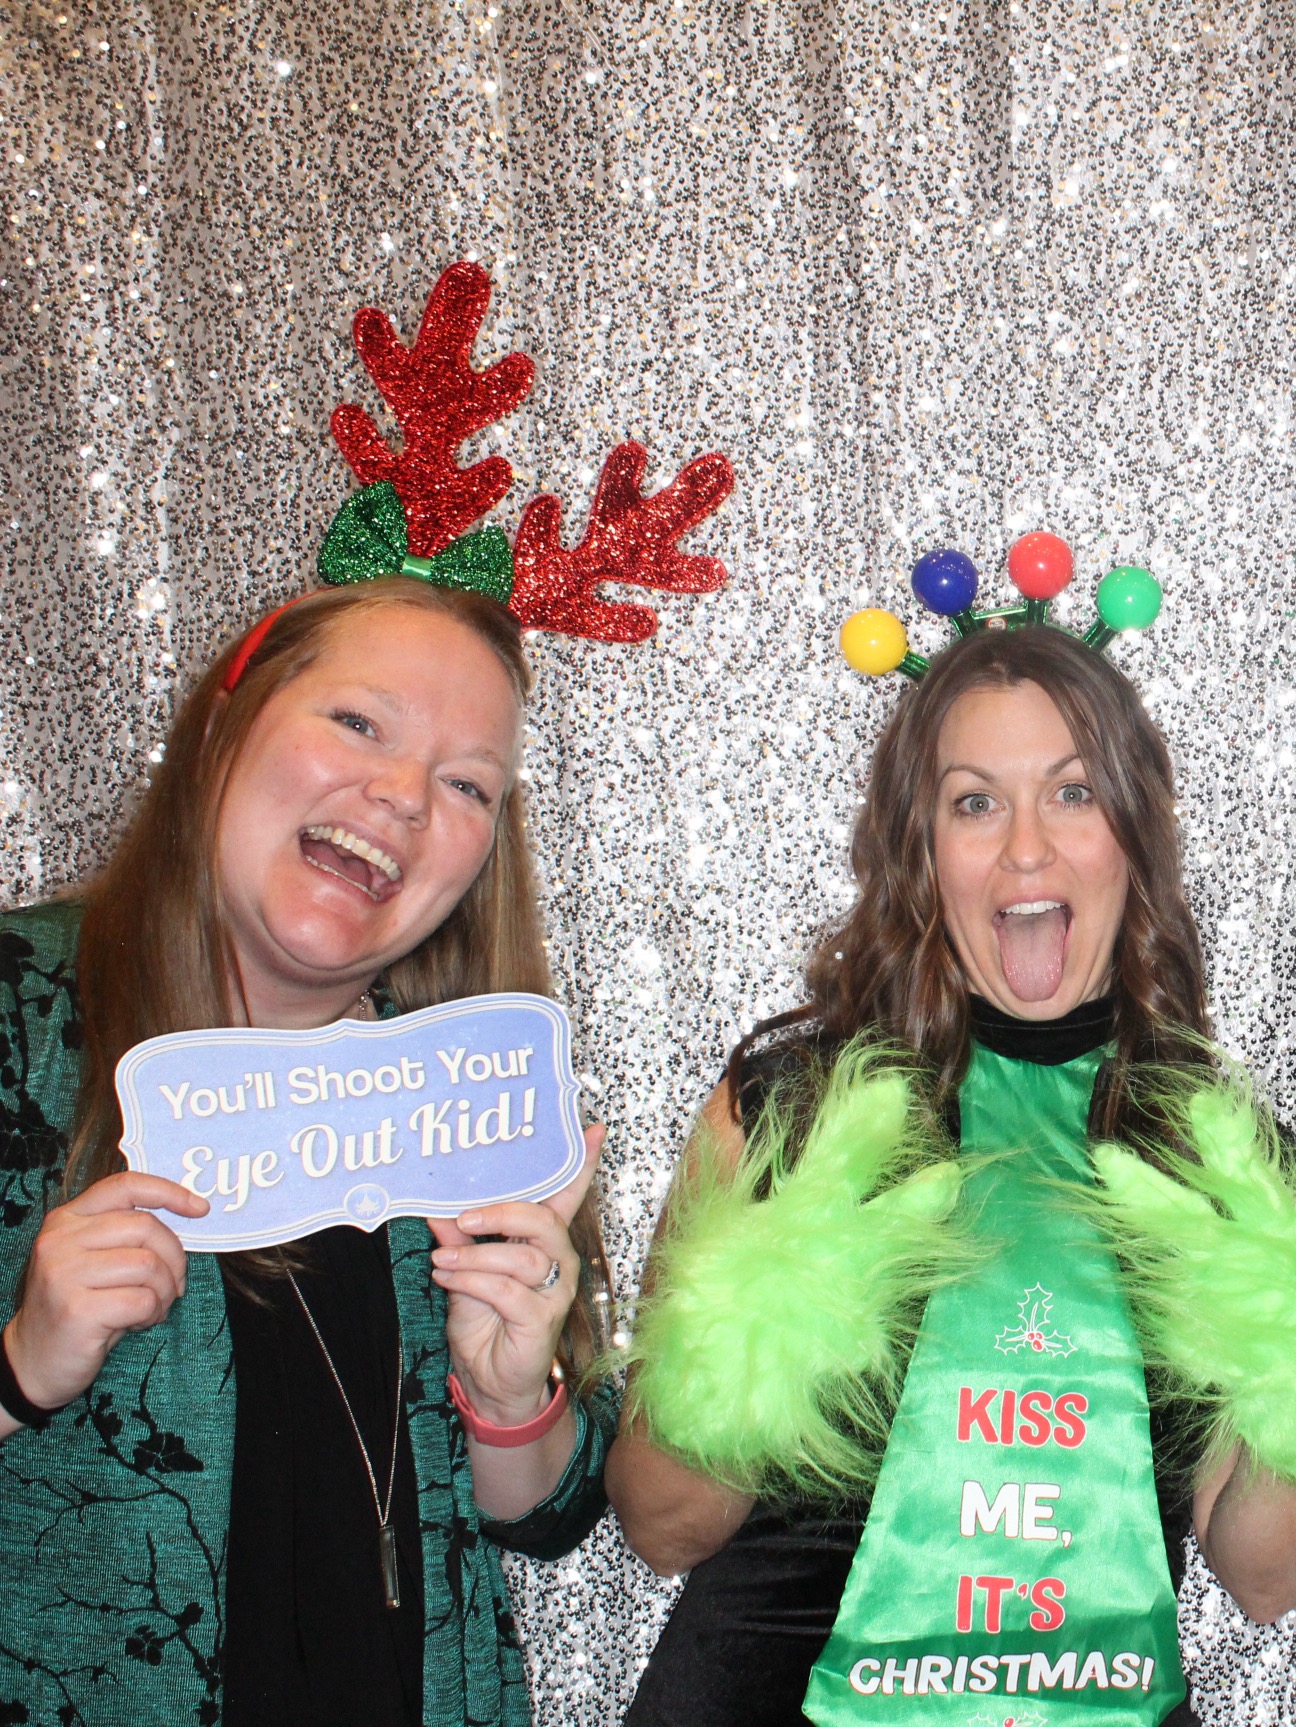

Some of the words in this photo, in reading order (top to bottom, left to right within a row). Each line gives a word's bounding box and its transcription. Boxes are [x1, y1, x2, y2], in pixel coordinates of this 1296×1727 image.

[159, 1072, 276, 1120] You'll
[288, 1056, 425, 1105] Shoot
[435, 1046, 535, 1084] Your
[180, 1145, 285, 1212] Eye
[290, 1115, 403, 1178] Out
[409, 1087, 536, 1157] Kid!
[956, 1386, 1088, 1449] KISS
[959, 1480, 1073, 1548] ME,
[955, 1574, 1066, 1634] IT'S
[848, 1650, 1156, 1696] CHRISTMAS!
